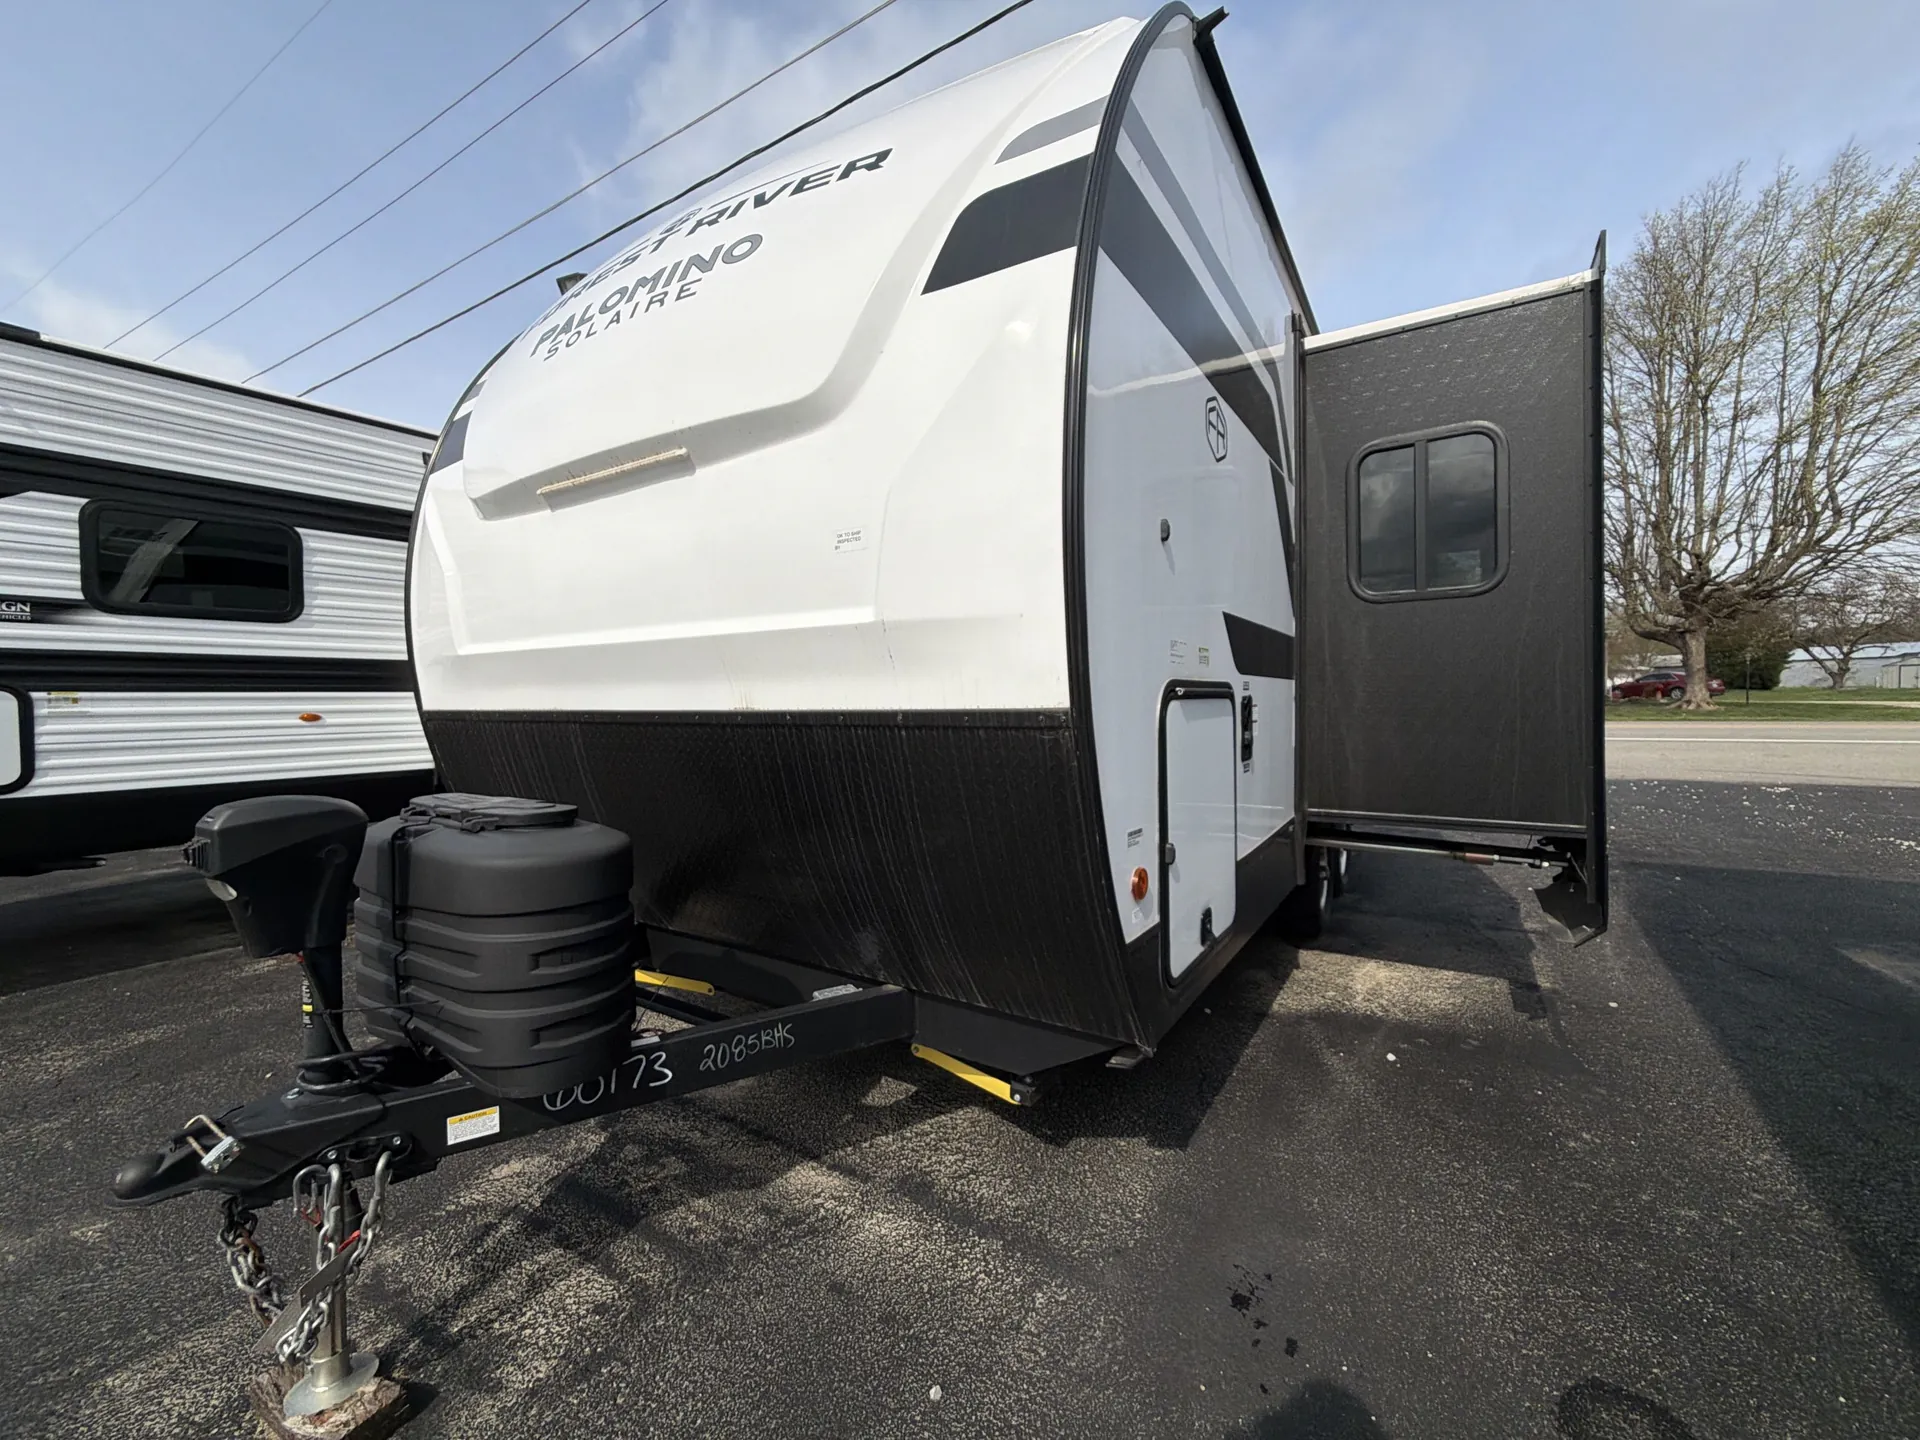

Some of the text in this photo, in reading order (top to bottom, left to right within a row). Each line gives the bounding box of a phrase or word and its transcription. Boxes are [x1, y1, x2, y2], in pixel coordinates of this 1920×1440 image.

[685, 148, 893, 238] RIVER
[529, 233, 763, 358] PALOMINO
[543, 277, 702, 362] SOLAIRE
[700, 1022, 796, 1072] 2085BHS
[464, 1110, 488, 1121] CAUTION
